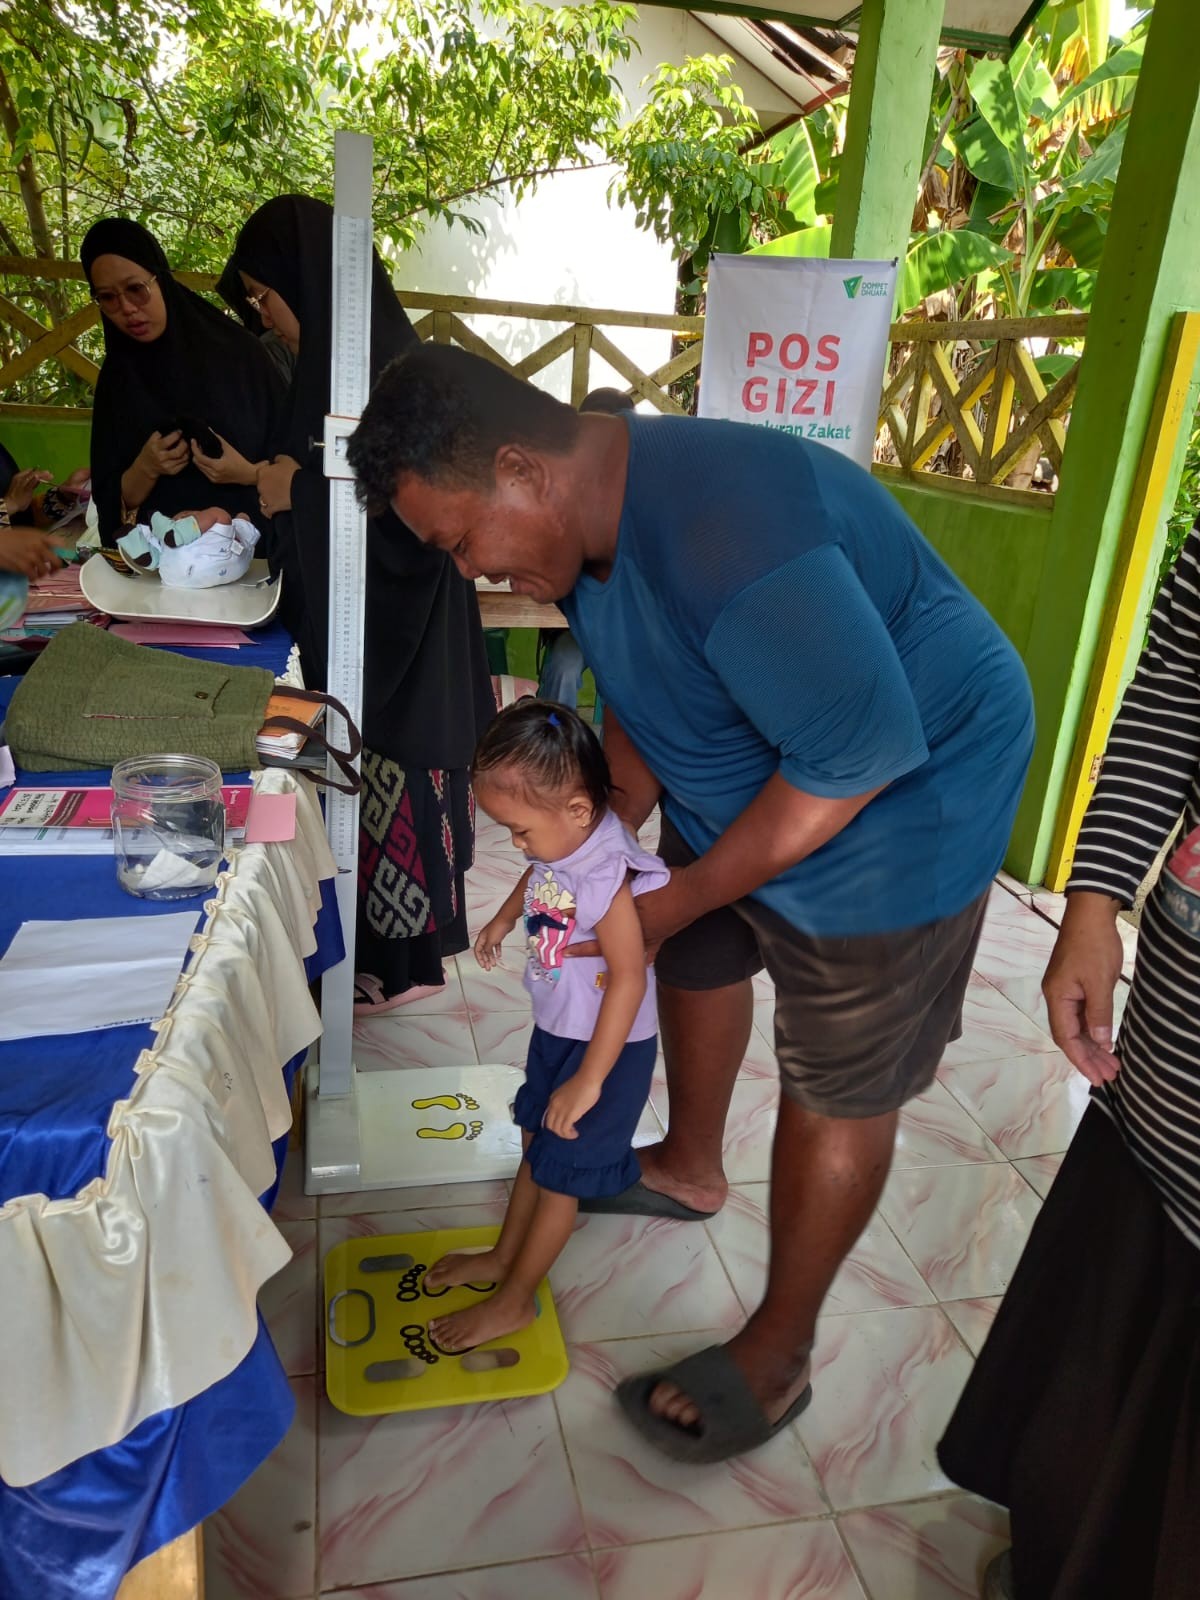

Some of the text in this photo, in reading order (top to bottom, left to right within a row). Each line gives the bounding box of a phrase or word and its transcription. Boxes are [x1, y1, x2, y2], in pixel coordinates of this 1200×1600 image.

[861, 282, 888, 290] DOMPET
[746, 332, 841, 372] POS
[741, 376, 836, 416] GIZI
[807, 423, 852, 439] Zakat
